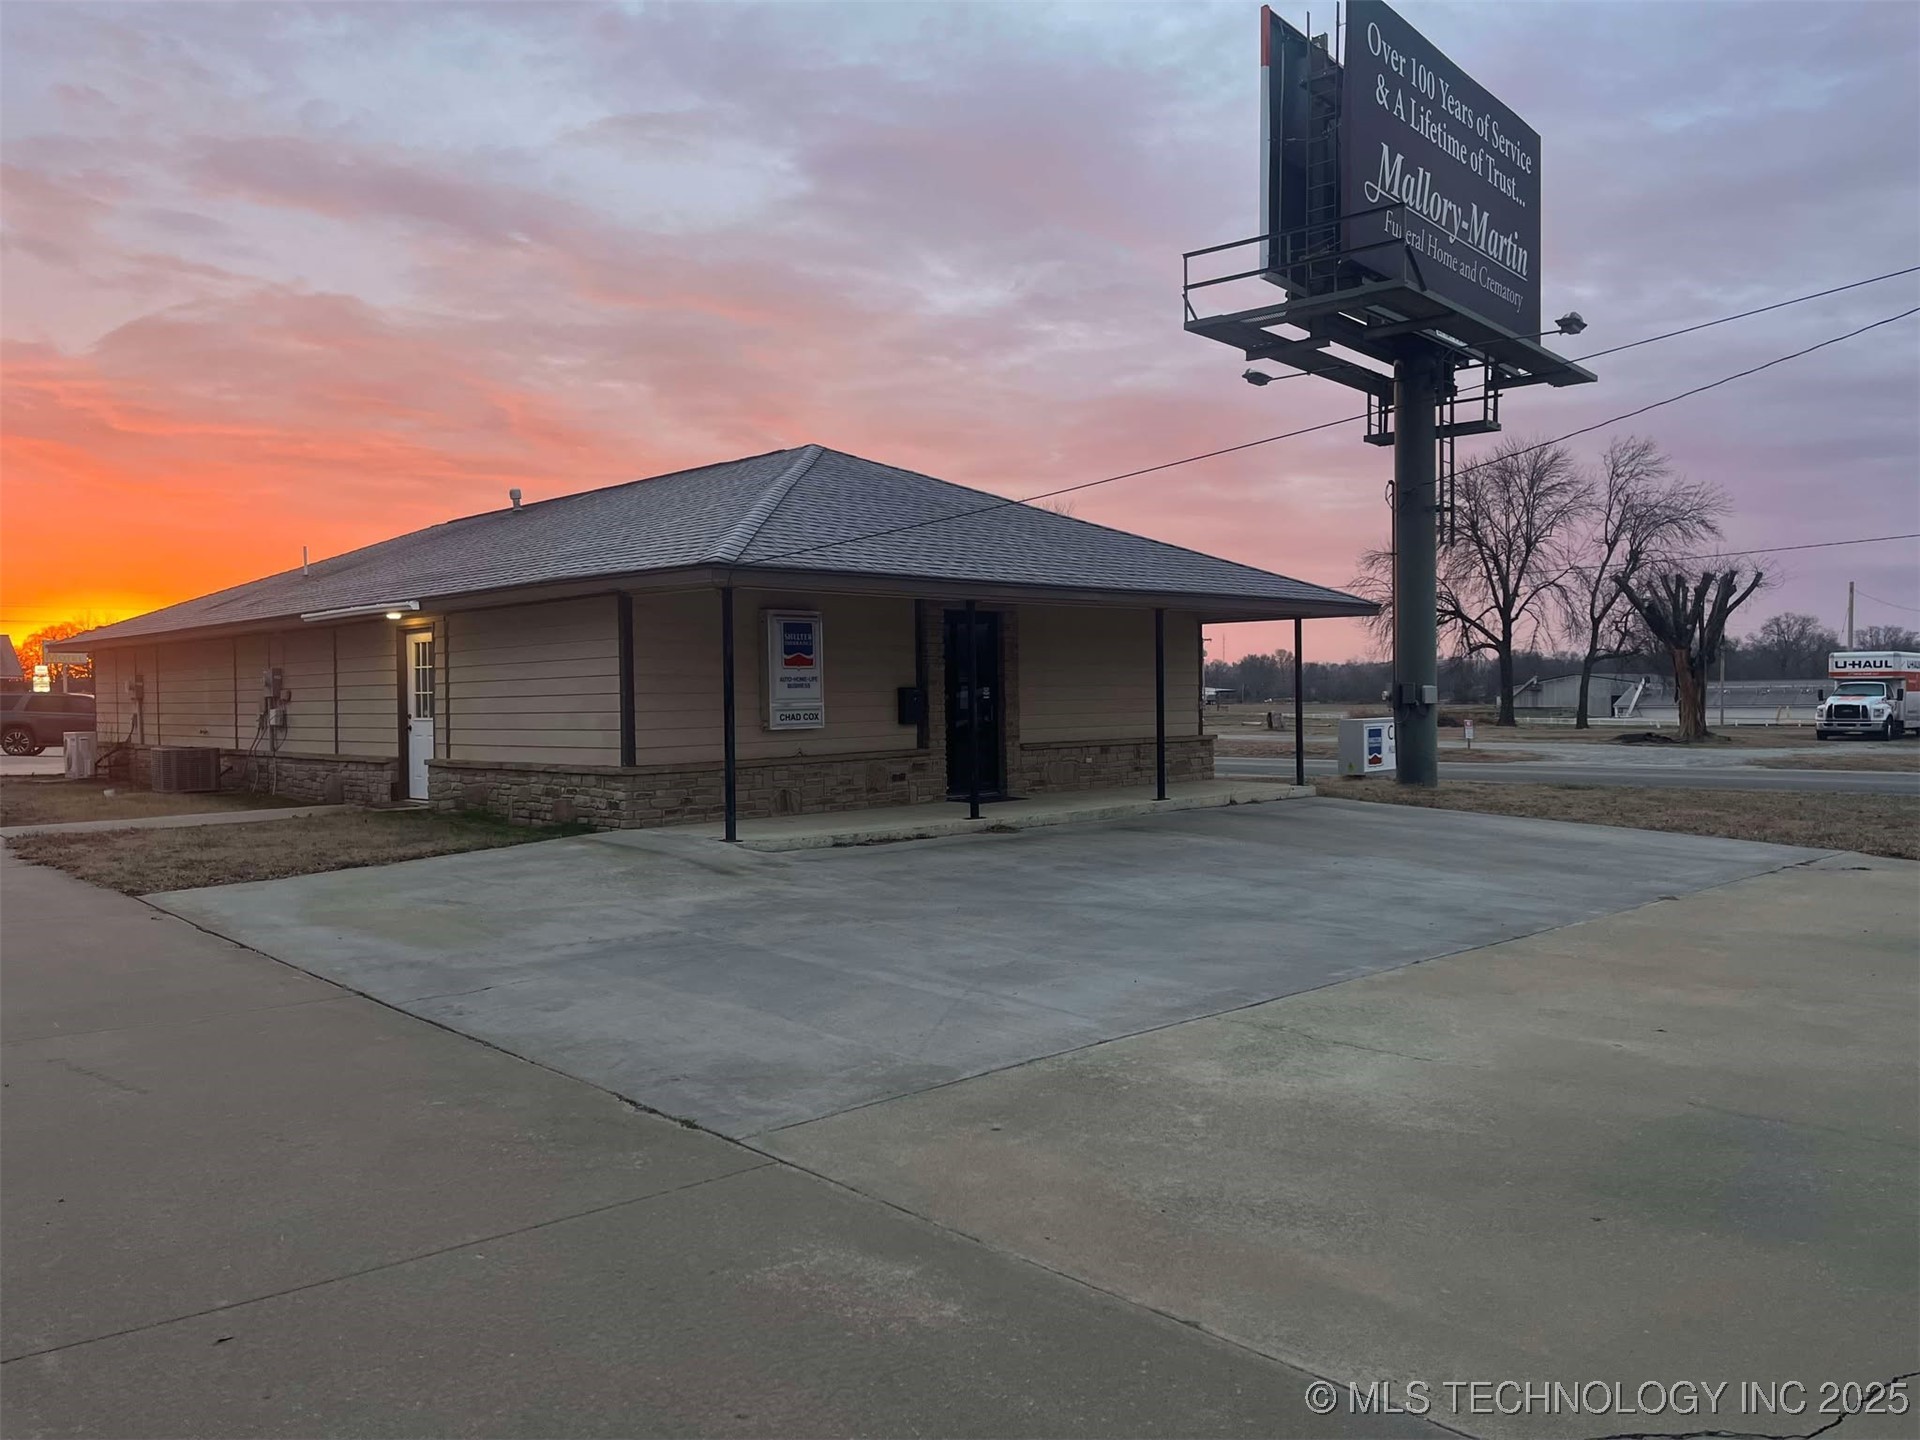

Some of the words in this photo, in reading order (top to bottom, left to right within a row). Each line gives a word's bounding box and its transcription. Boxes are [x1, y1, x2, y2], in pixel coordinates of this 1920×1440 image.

[1367, 22, 1406, 77] Over
[1411, 57, 1435, 100] 100
[1439, 77, 1473, 129] Years
[1476, 113, 1491, 142] of
[1492, 120, 1532, 174] Service
[1375, 73, 1390, 110] &
[1393, 88, 1406, 122] A
[1410, 97, 1467, 164] Lifetime
[1470, 149, 1484, 177] of
[1486, 154, 1526, 207] Trust...
[1364, 142, 1529, 277] Mallory-Martin
[1427, 234, 1458, 272] Home
[1459, 260, 1477, 282] and
[1479, 266, 1524, 313] Crematory
[779, 713, 802, 722] CHAD
[803, 713, 820, 721] COX
[1834, 660, 1893, 669] U-HAUL
